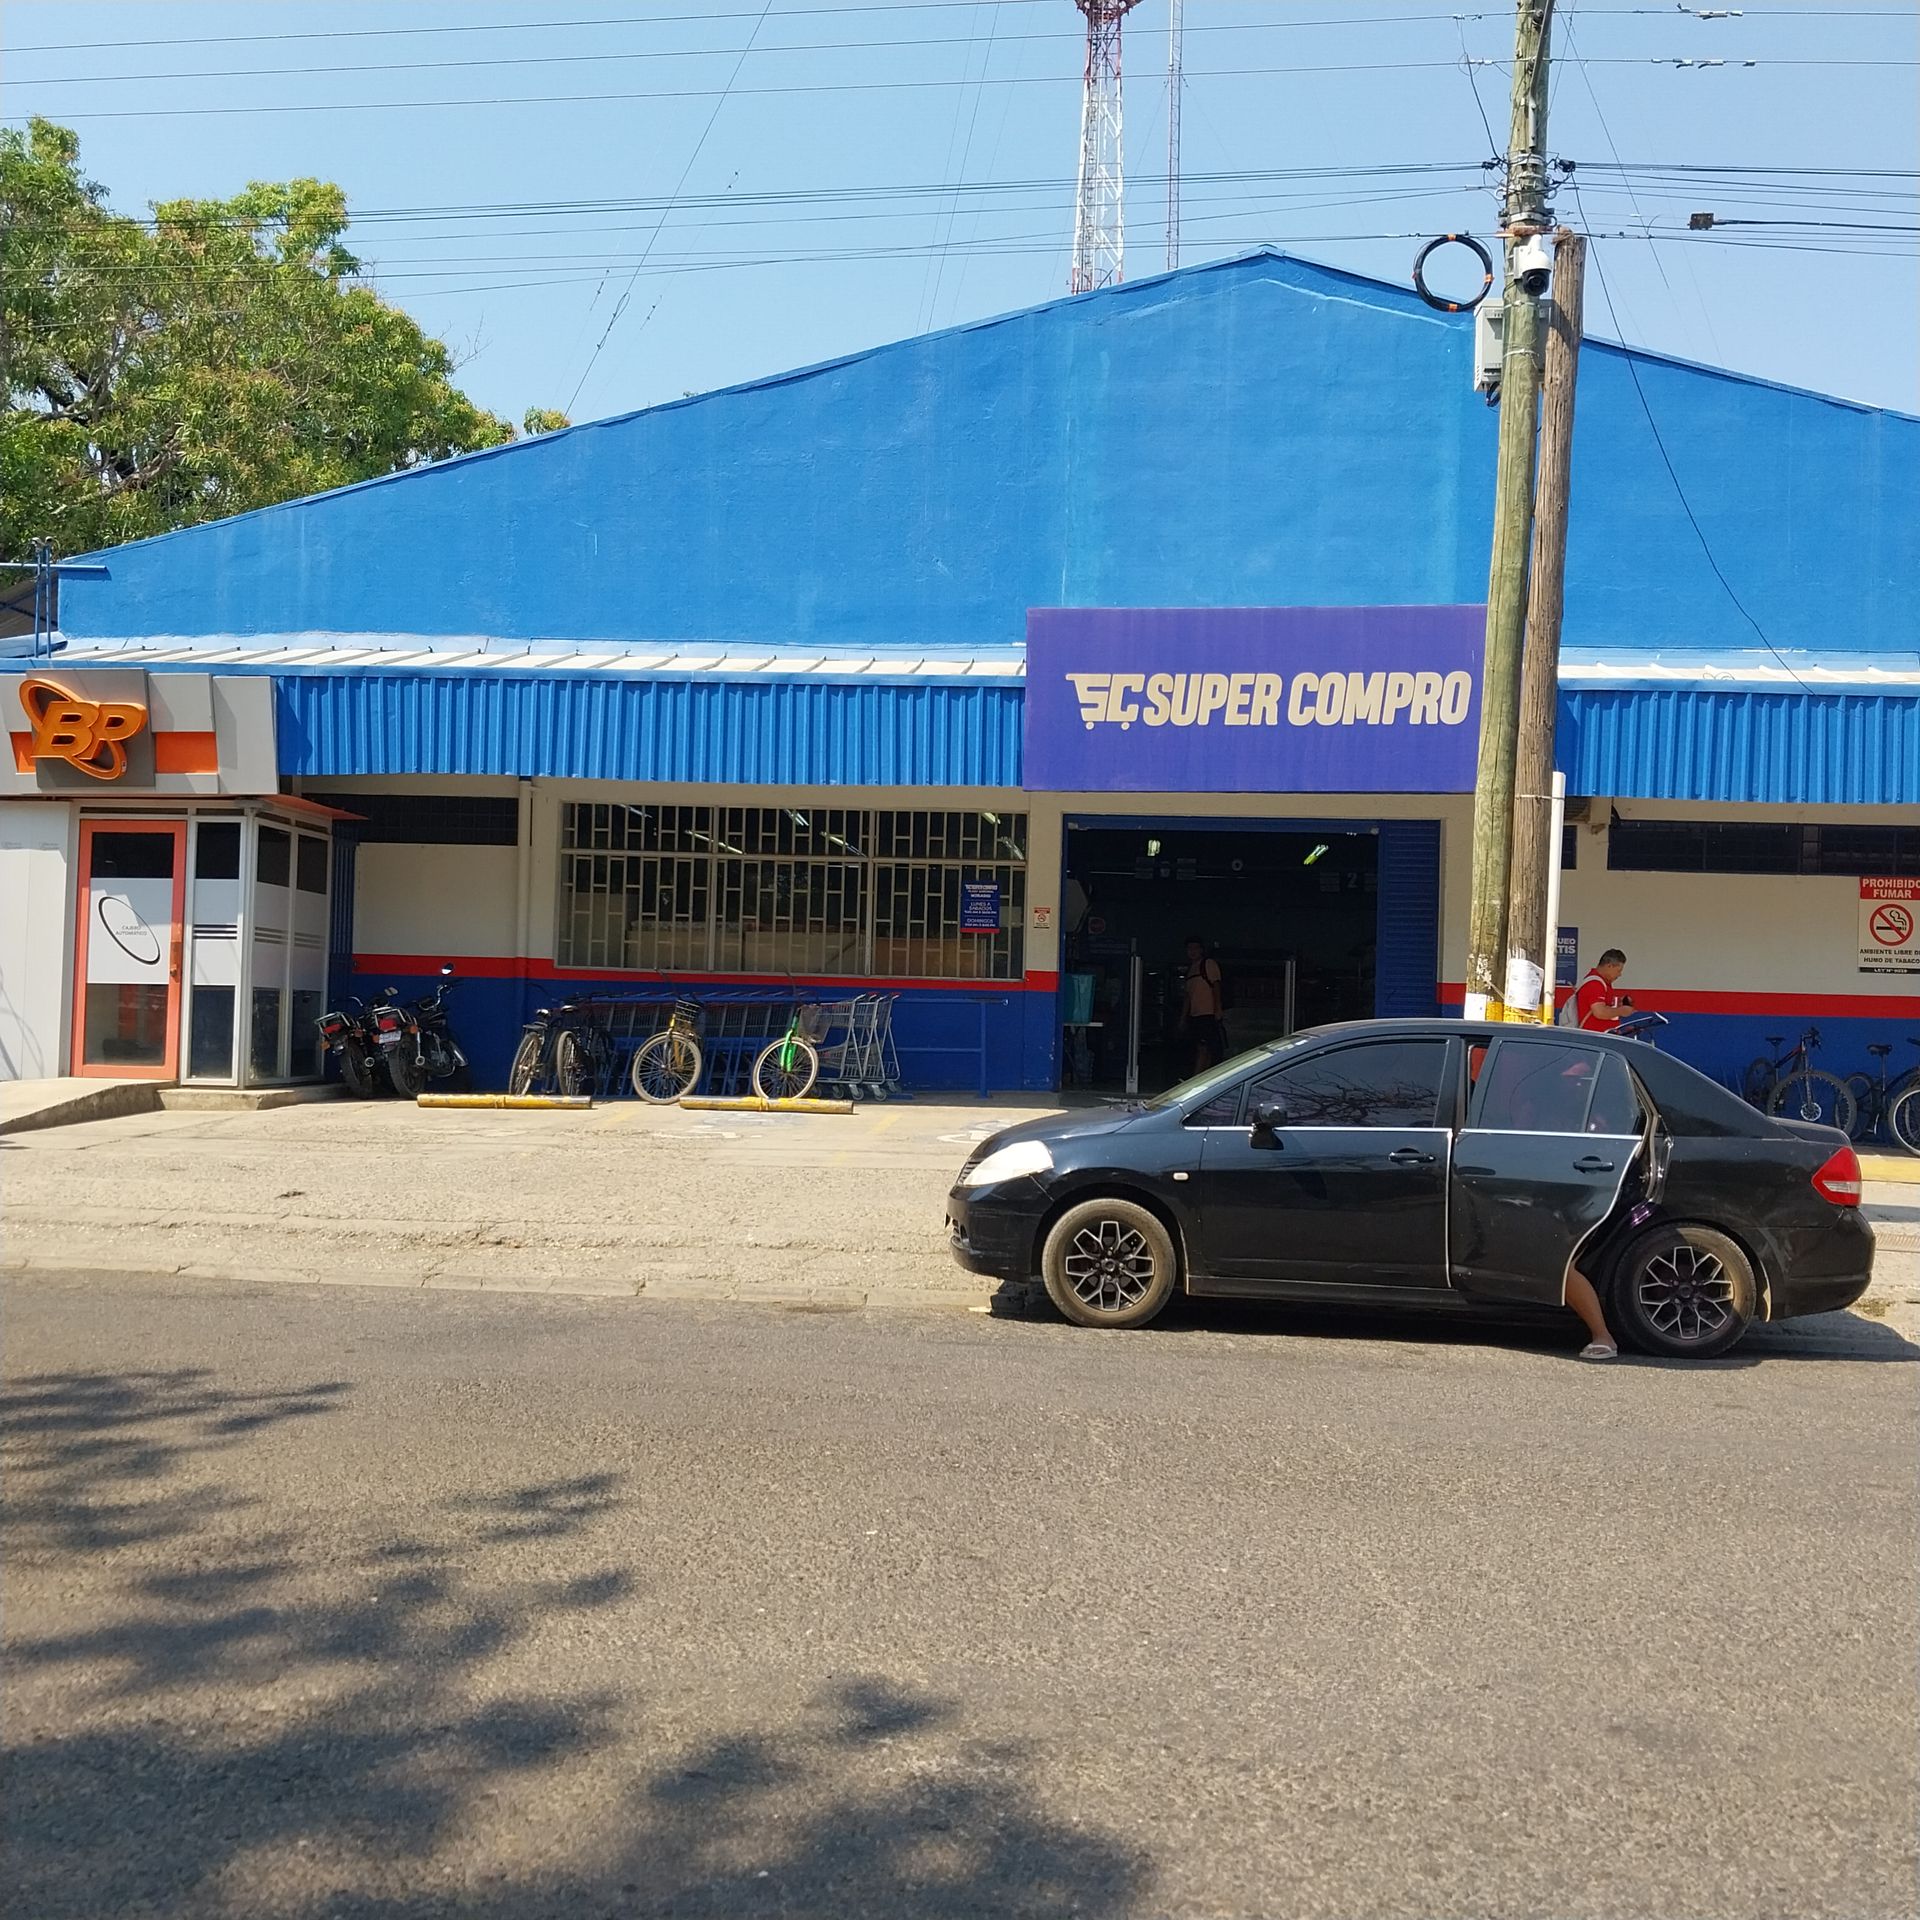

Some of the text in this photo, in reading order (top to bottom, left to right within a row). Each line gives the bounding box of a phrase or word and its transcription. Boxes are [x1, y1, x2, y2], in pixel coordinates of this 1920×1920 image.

[1143, 673, 1282, 727] SUPER
[1288, 671, 1472, 726] COMPRO
[30, 700, 147, 760] BP
[1862, 878, 1920, 889] PROHIBIDO
[1873, 889, 1912, 899] FUMAR
